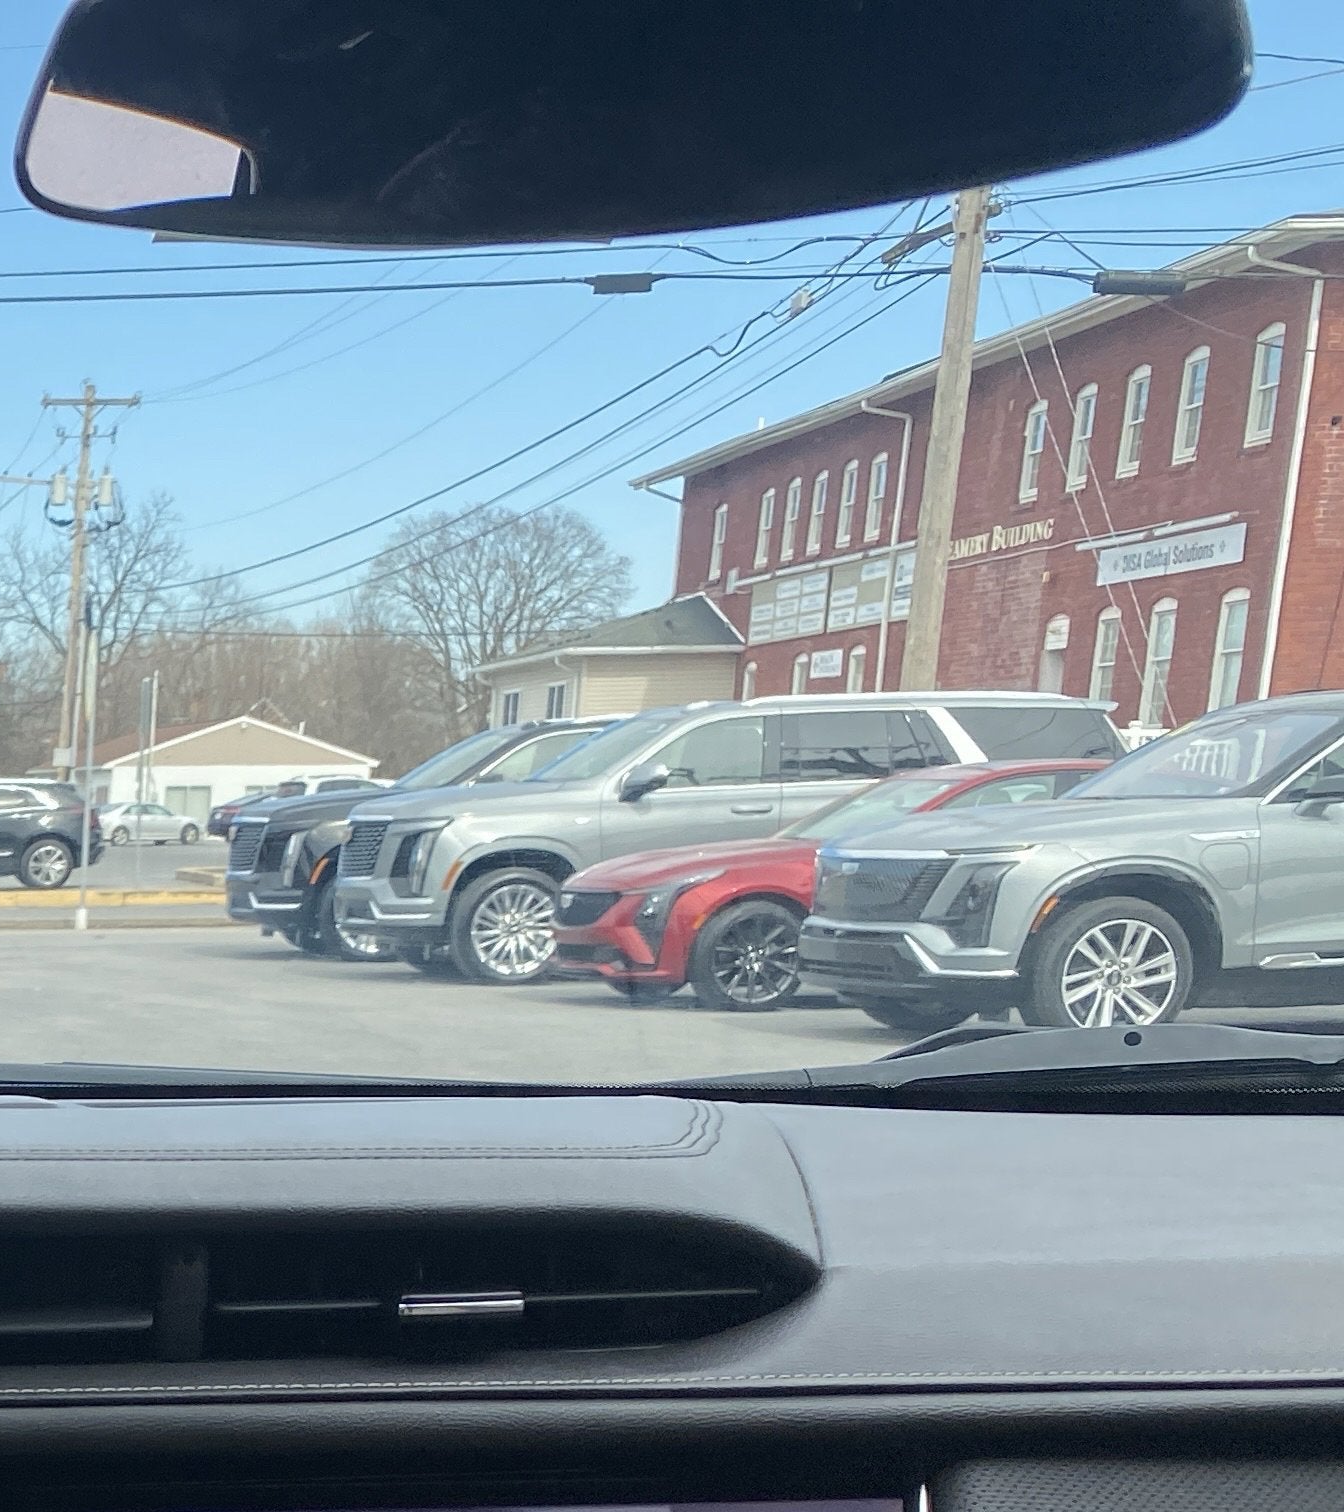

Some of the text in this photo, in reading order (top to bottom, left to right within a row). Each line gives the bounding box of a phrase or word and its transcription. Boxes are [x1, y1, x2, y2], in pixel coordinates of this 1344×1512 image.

[992, 519, 1054, 551] BUILDING
[1144, 546, 1171, 569] Global
[1173, 541, 1215, 565] Solutions
